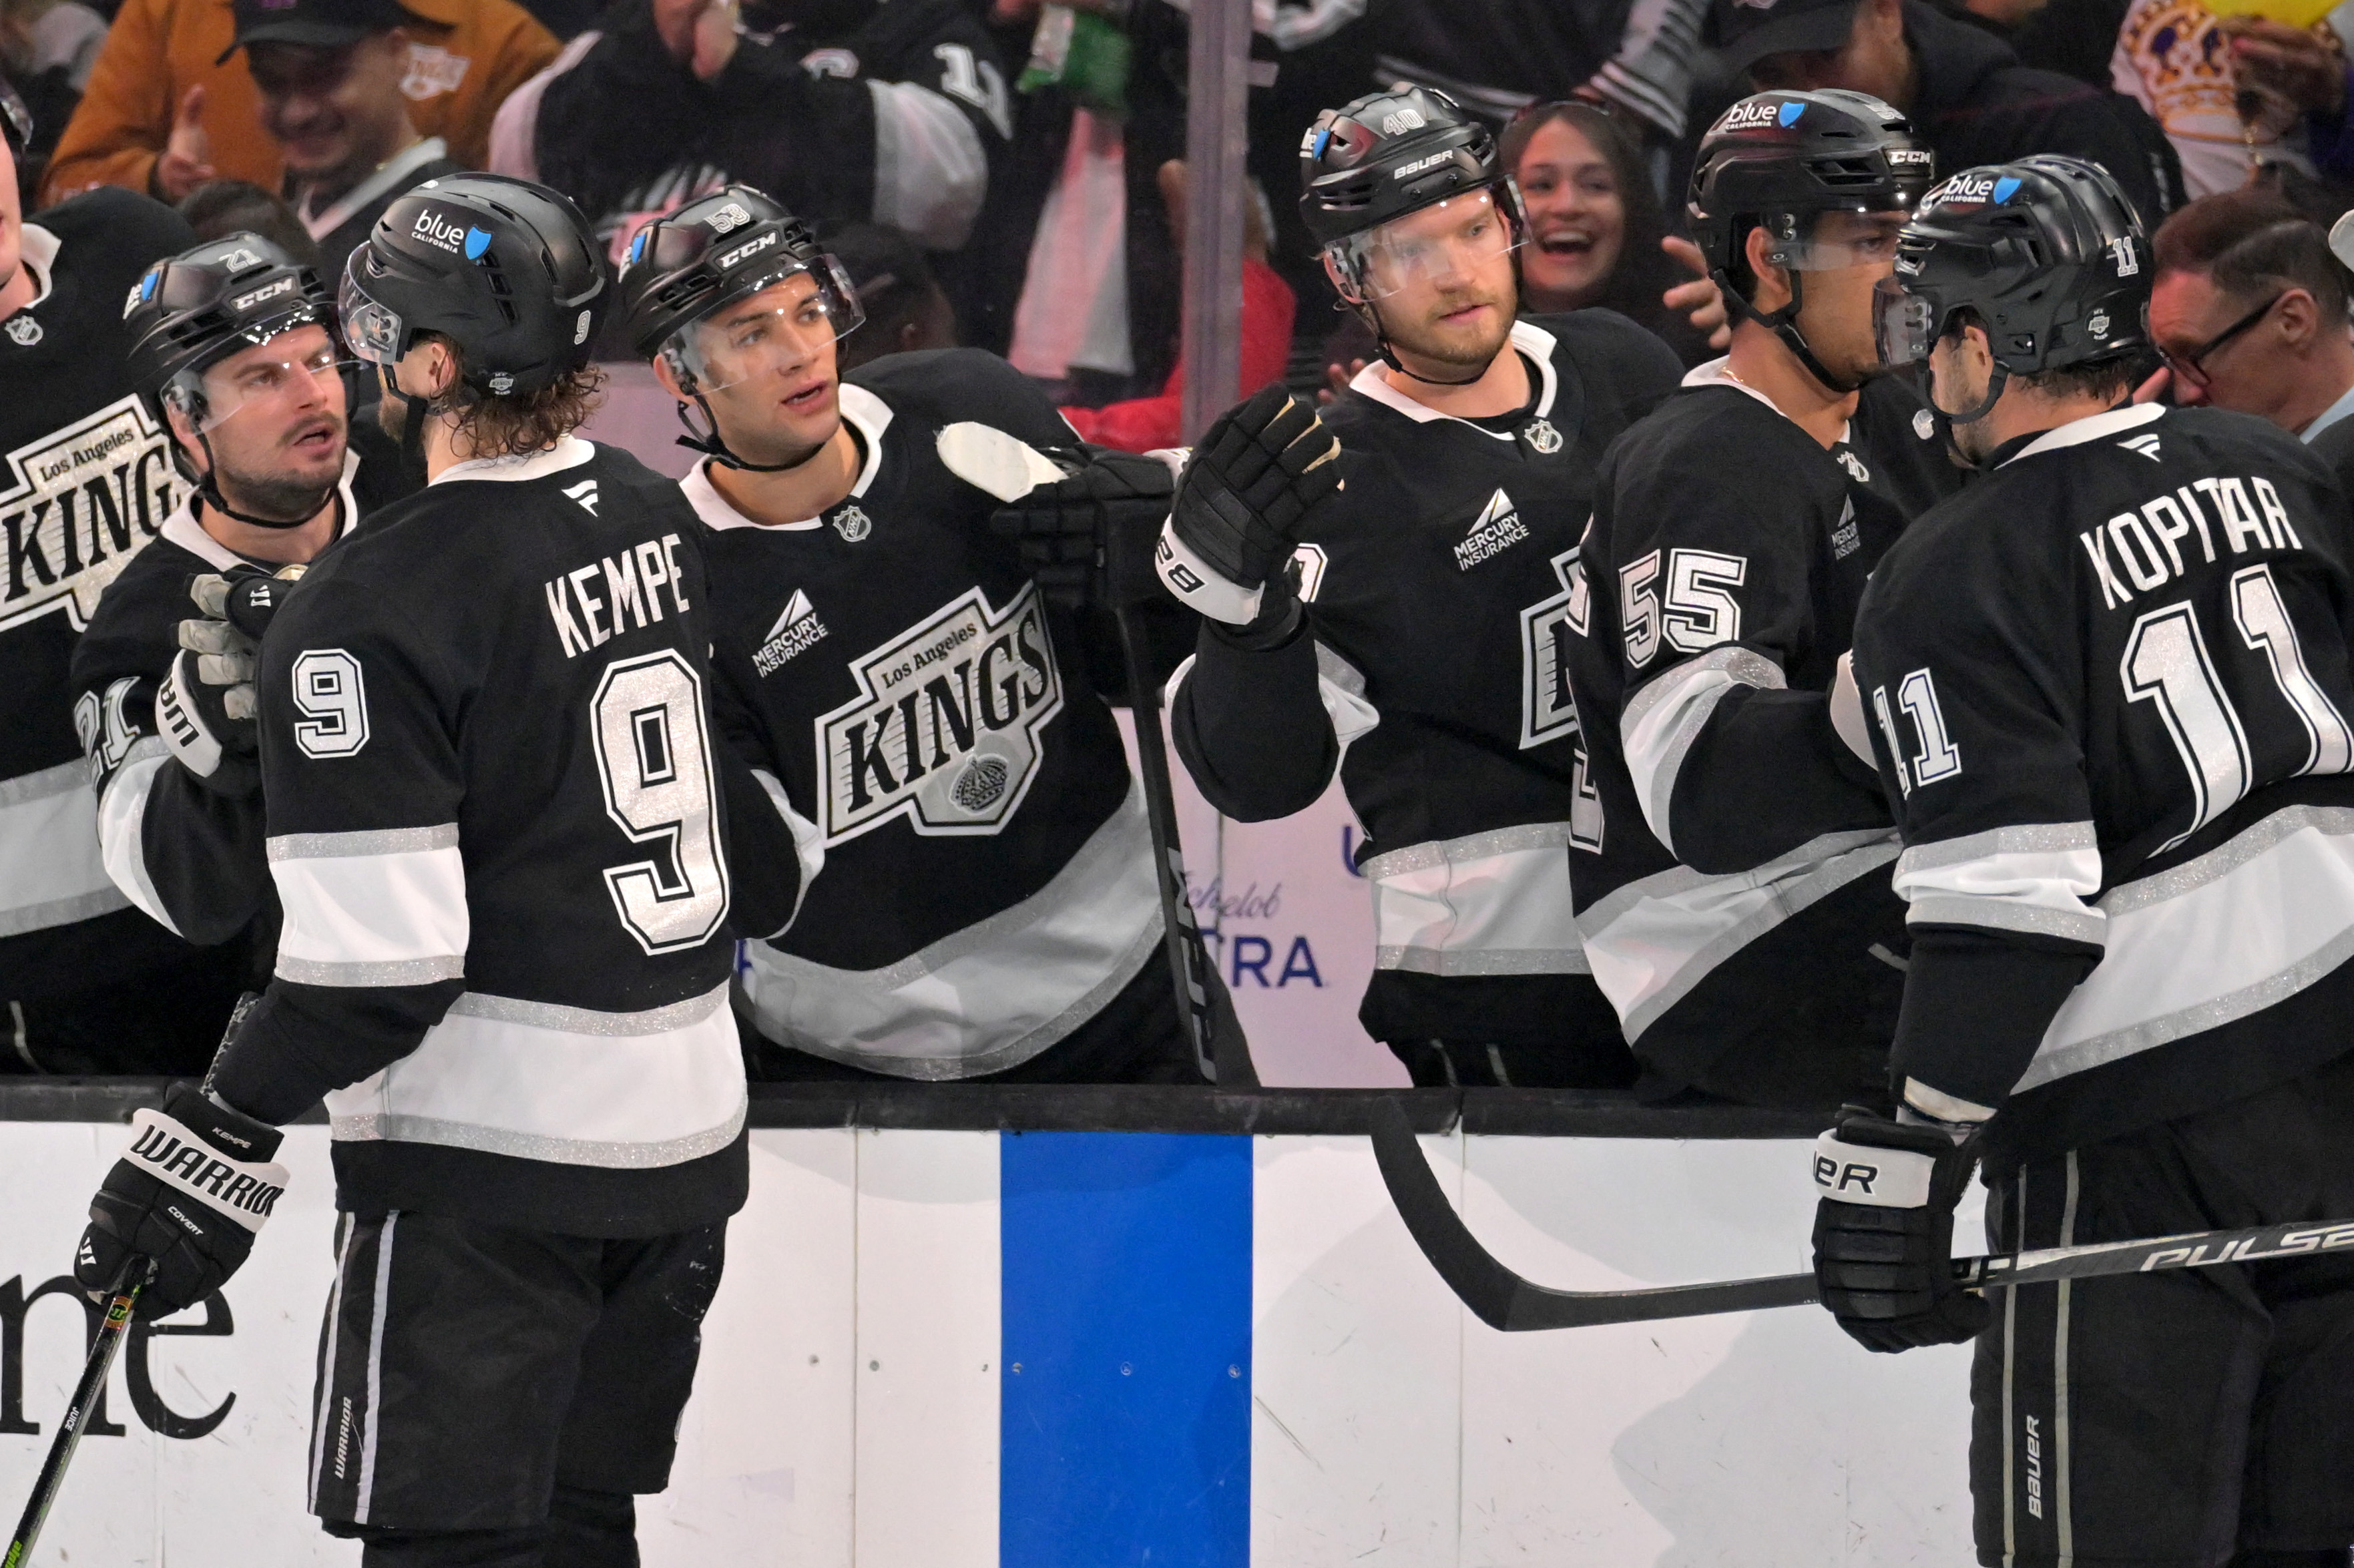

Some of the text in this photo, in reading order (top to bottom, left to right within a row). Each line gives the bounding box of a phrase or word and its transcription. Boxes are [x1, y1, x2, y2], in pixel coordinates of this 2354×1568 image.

[1383, 109, 1425, 136] 40
[1725, 120, 1772, 130] CALIFORNIA
[1727, 101, 1777, 123] blue
[1890, 151, 1931, 164] CCM
[1940, 194, 1987, 203] CALIFORNIA
[1943, 175, 1993, 196] blue
[415, 209, 465, 246] blue
[703, 203, 751, 234] 53
[219, 248, 262, 273] 21
[411, 231, 458, 254] CALIFORNIA
[719, 232, 776, 268] CCM
[2112, 236, 2139, 278] 11
[236, 278, 293, 310] CCM
[573, 310, 592, 346] 9
[39, 429, 135, 482] Los Angeles
[1, 445, 182, 601] KING
[1453, 512, 1520, 560] MERCURY
[2080, 476, 2303, 610] KOPITAR
[1458, 524, 1530, 571] INSURANCE
[545, 533, 690, 659] KEMPE
[1618, 548, 1748, 669] 55
[751, 612, 818, 668] MERCURY
[757, 623, 829, 678] INSURANCE
[880, 622, 978, 690] Los Angeles
[292, 648, 370, 759] 9
[845, 608, 1049, 814] KINGS
[2119, 562, 2354, 859] 11
[73, 676, 142, 792] 21
[1873, 668, 1962, 800] 11
[590, 647, 730, 956] 9
[1200, 928, 1324, 988] RA
[212, 1127, 252, 1149] KEMPE
[168, 1205, 204, 1236] COVERT
[64, 1406, 79, 1432] JUICE
[334, 1396, 352, 1479] WARRIOR
